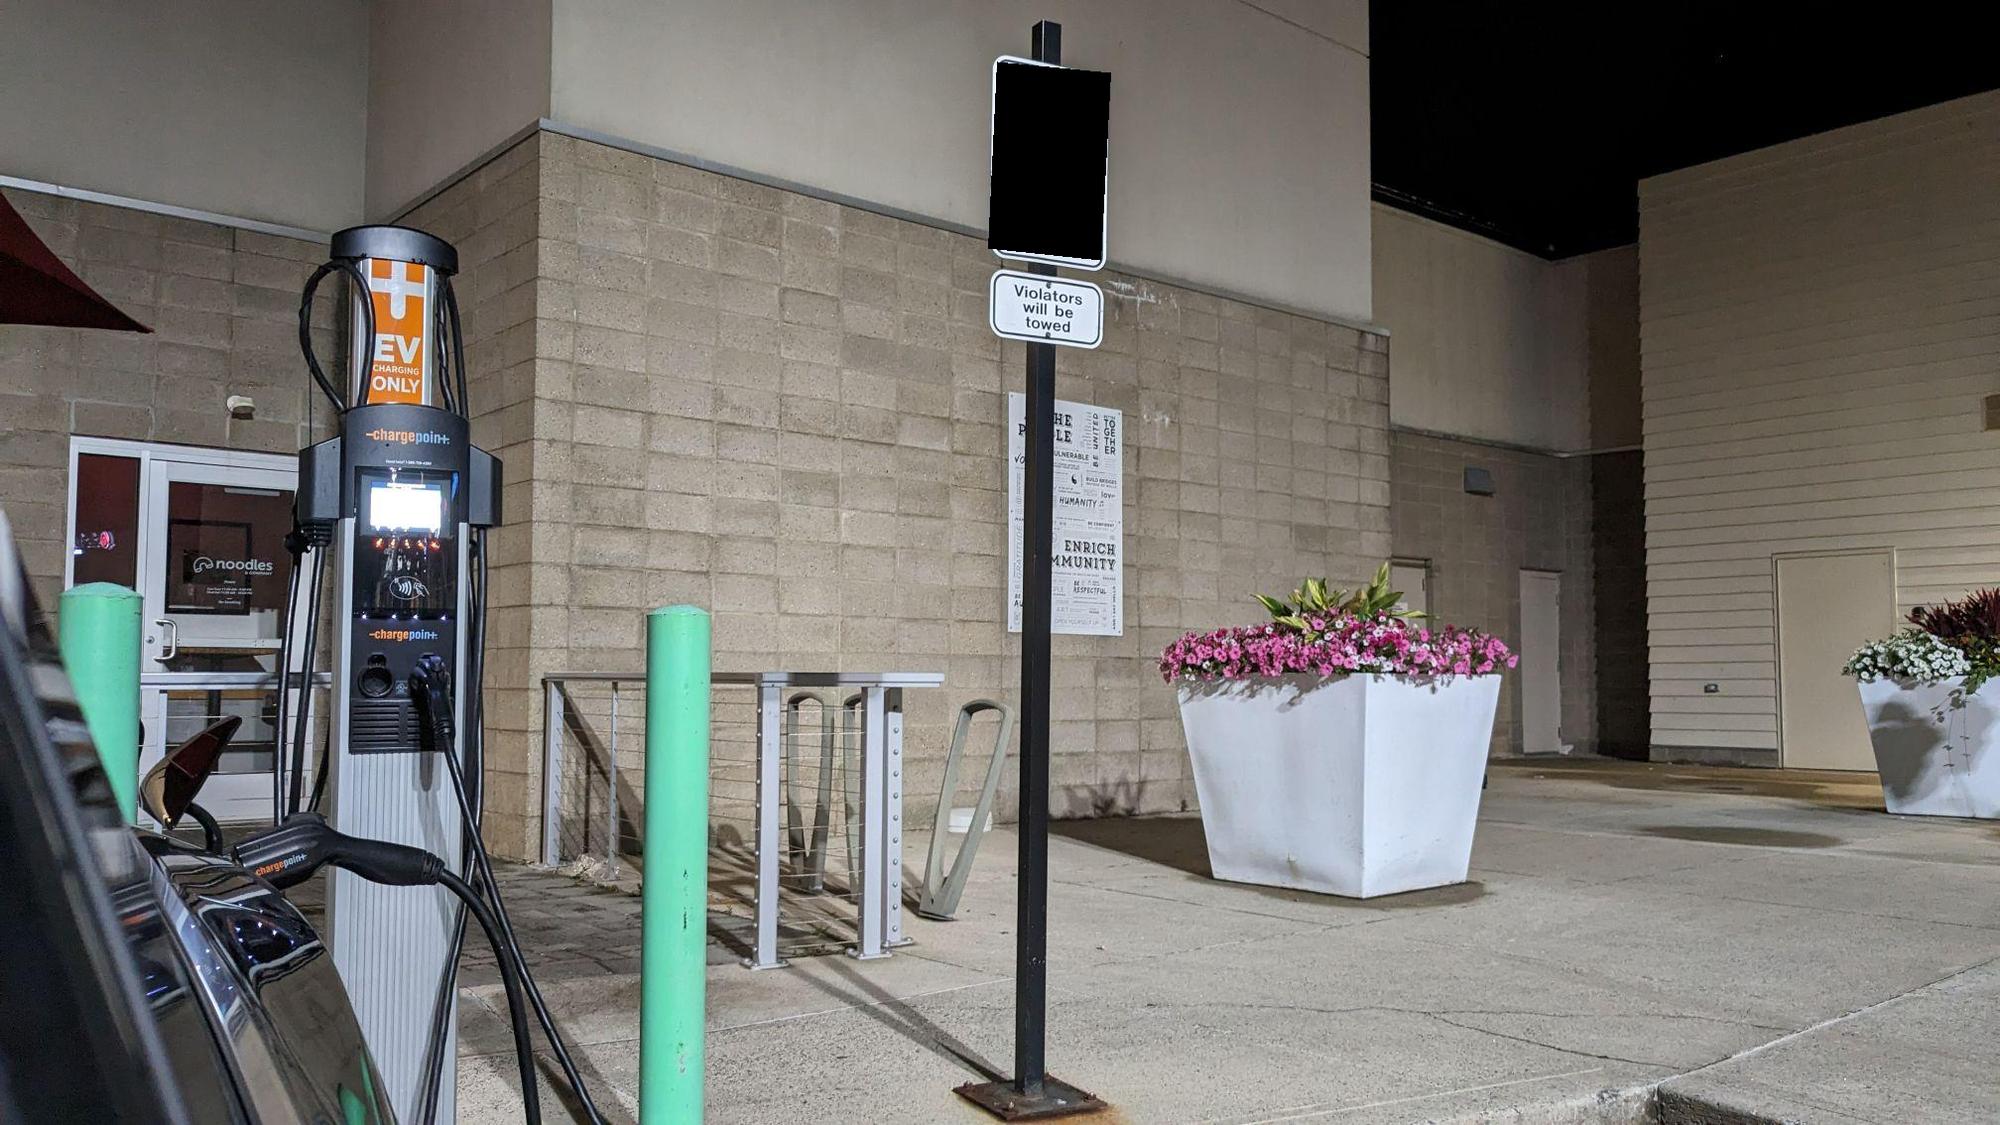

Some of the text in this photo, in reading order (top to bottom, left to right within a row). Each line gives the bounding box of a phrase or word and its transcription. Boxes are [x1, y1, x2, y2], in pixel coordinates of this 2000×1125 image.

[1014, 284, 1083, 306] Violators
[1023, 302, 1074, 319] will be
[1026, 317, 1071, 333] towed
[373, 332, 421, 364] EV
[372, 364, 420, 376] CHARGING
[372, 375, 421, 394] ONLY
[1054, 413, 1072, 427] HE
[1054, 451, 1089, 461] ULNERABLE
[1059, 496, 1097, 508] HUMANITY
[1065, 540, 1116, 556] ENRICH
[215, 558, 274, 571] noodles
[1052, 554, 1116, 571] MMUNITY
[1073, 586, 1108, 595] RESPECTFUL
